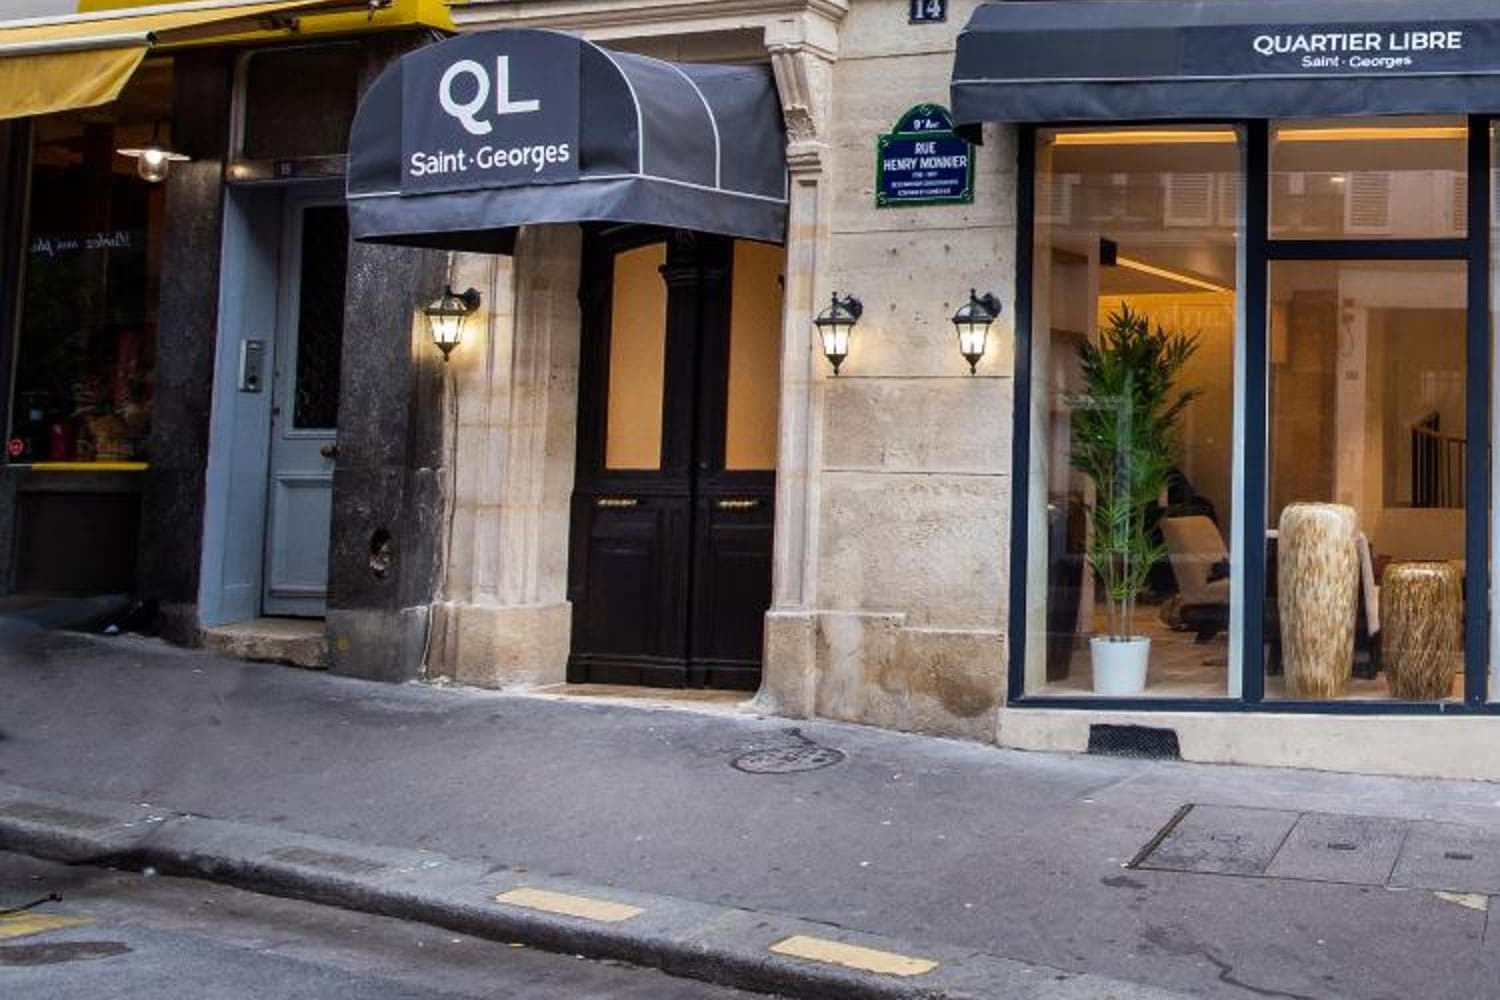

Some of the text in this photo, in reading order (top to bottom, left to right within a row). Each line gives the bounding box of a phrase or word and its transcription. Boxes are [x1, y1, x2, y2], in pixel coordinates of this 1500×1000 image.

[1252, 31, 1462, 55] QUARTIER LIBRE
[438, 54, 542, 136] QL
[914, 141, 937, 155] RUE
[883, 155, 967, 171] HENRY MONNIER
